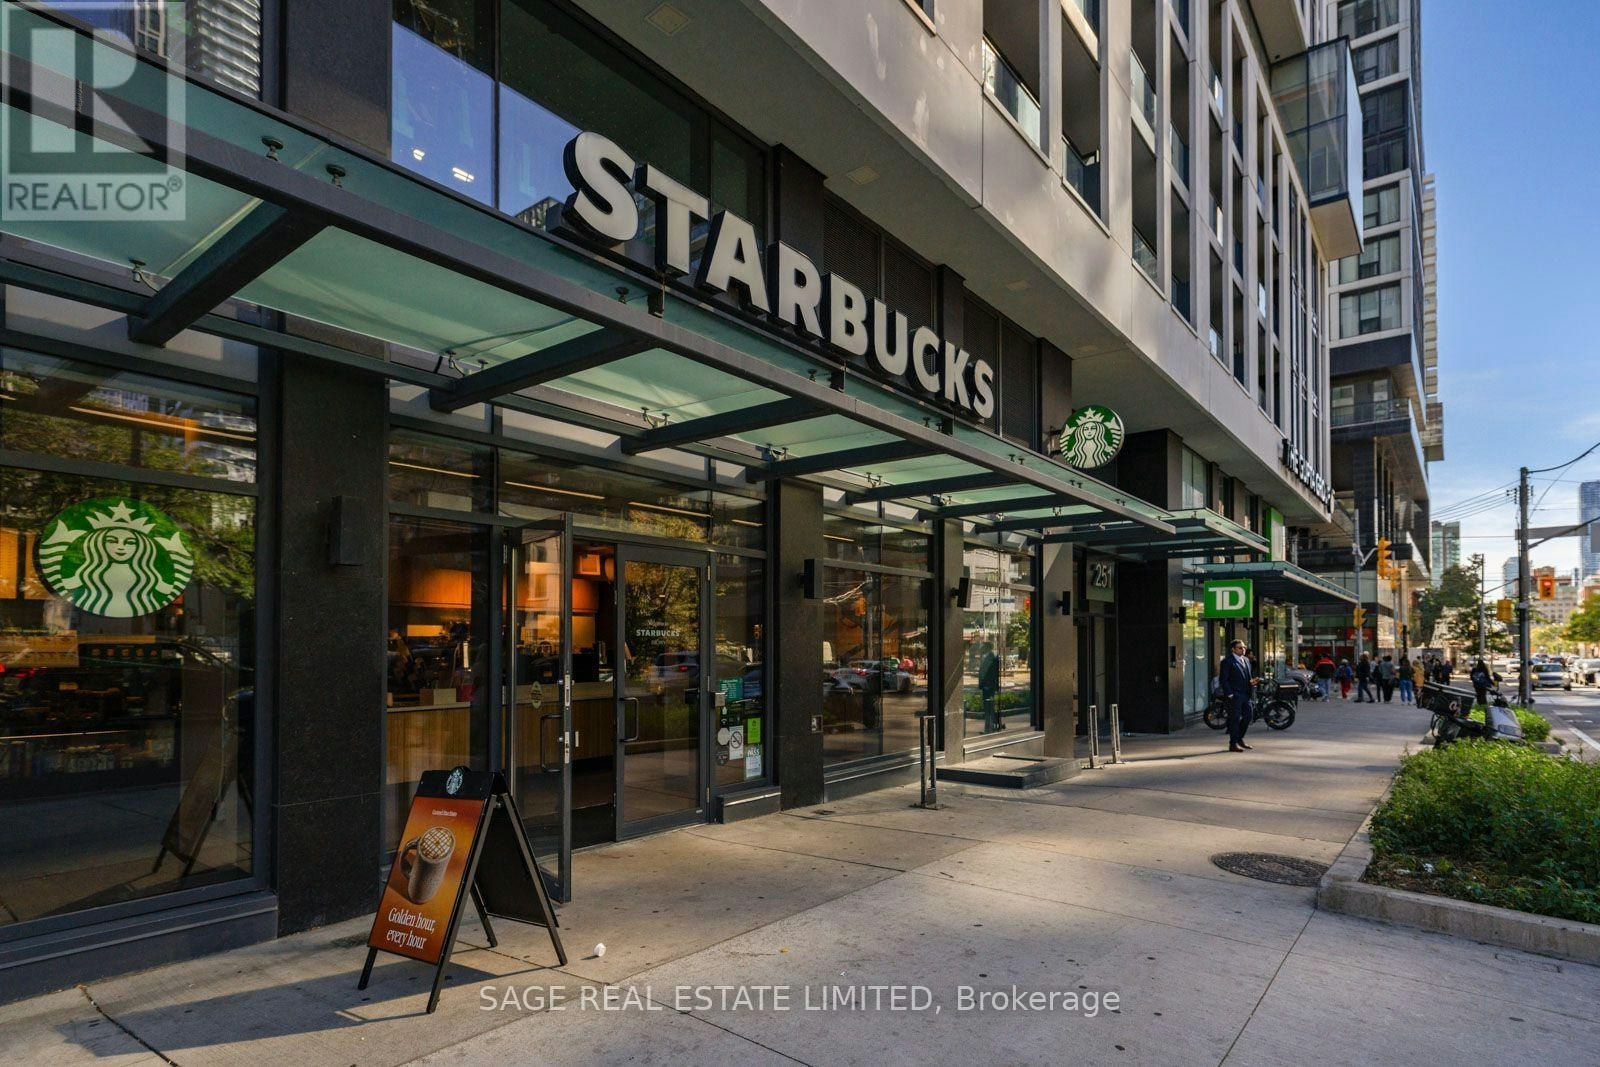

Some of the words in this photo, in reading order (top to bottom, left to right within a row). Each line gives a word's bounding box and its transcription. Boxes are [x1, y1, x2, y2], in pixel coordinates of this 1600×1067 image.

[562, 131, 995, 419] STARBUCKS
[1094, 563, 1112, 588] 251
[1208, 586, 1246, 610] TD
[636, 629, 680, 637] STARBUCKS
[388, 907, 416, 927] Golden
[415, 912, 436, 935] hour,
[386, 929, 408, 948] every
[406, 930, 427, 950] hour
